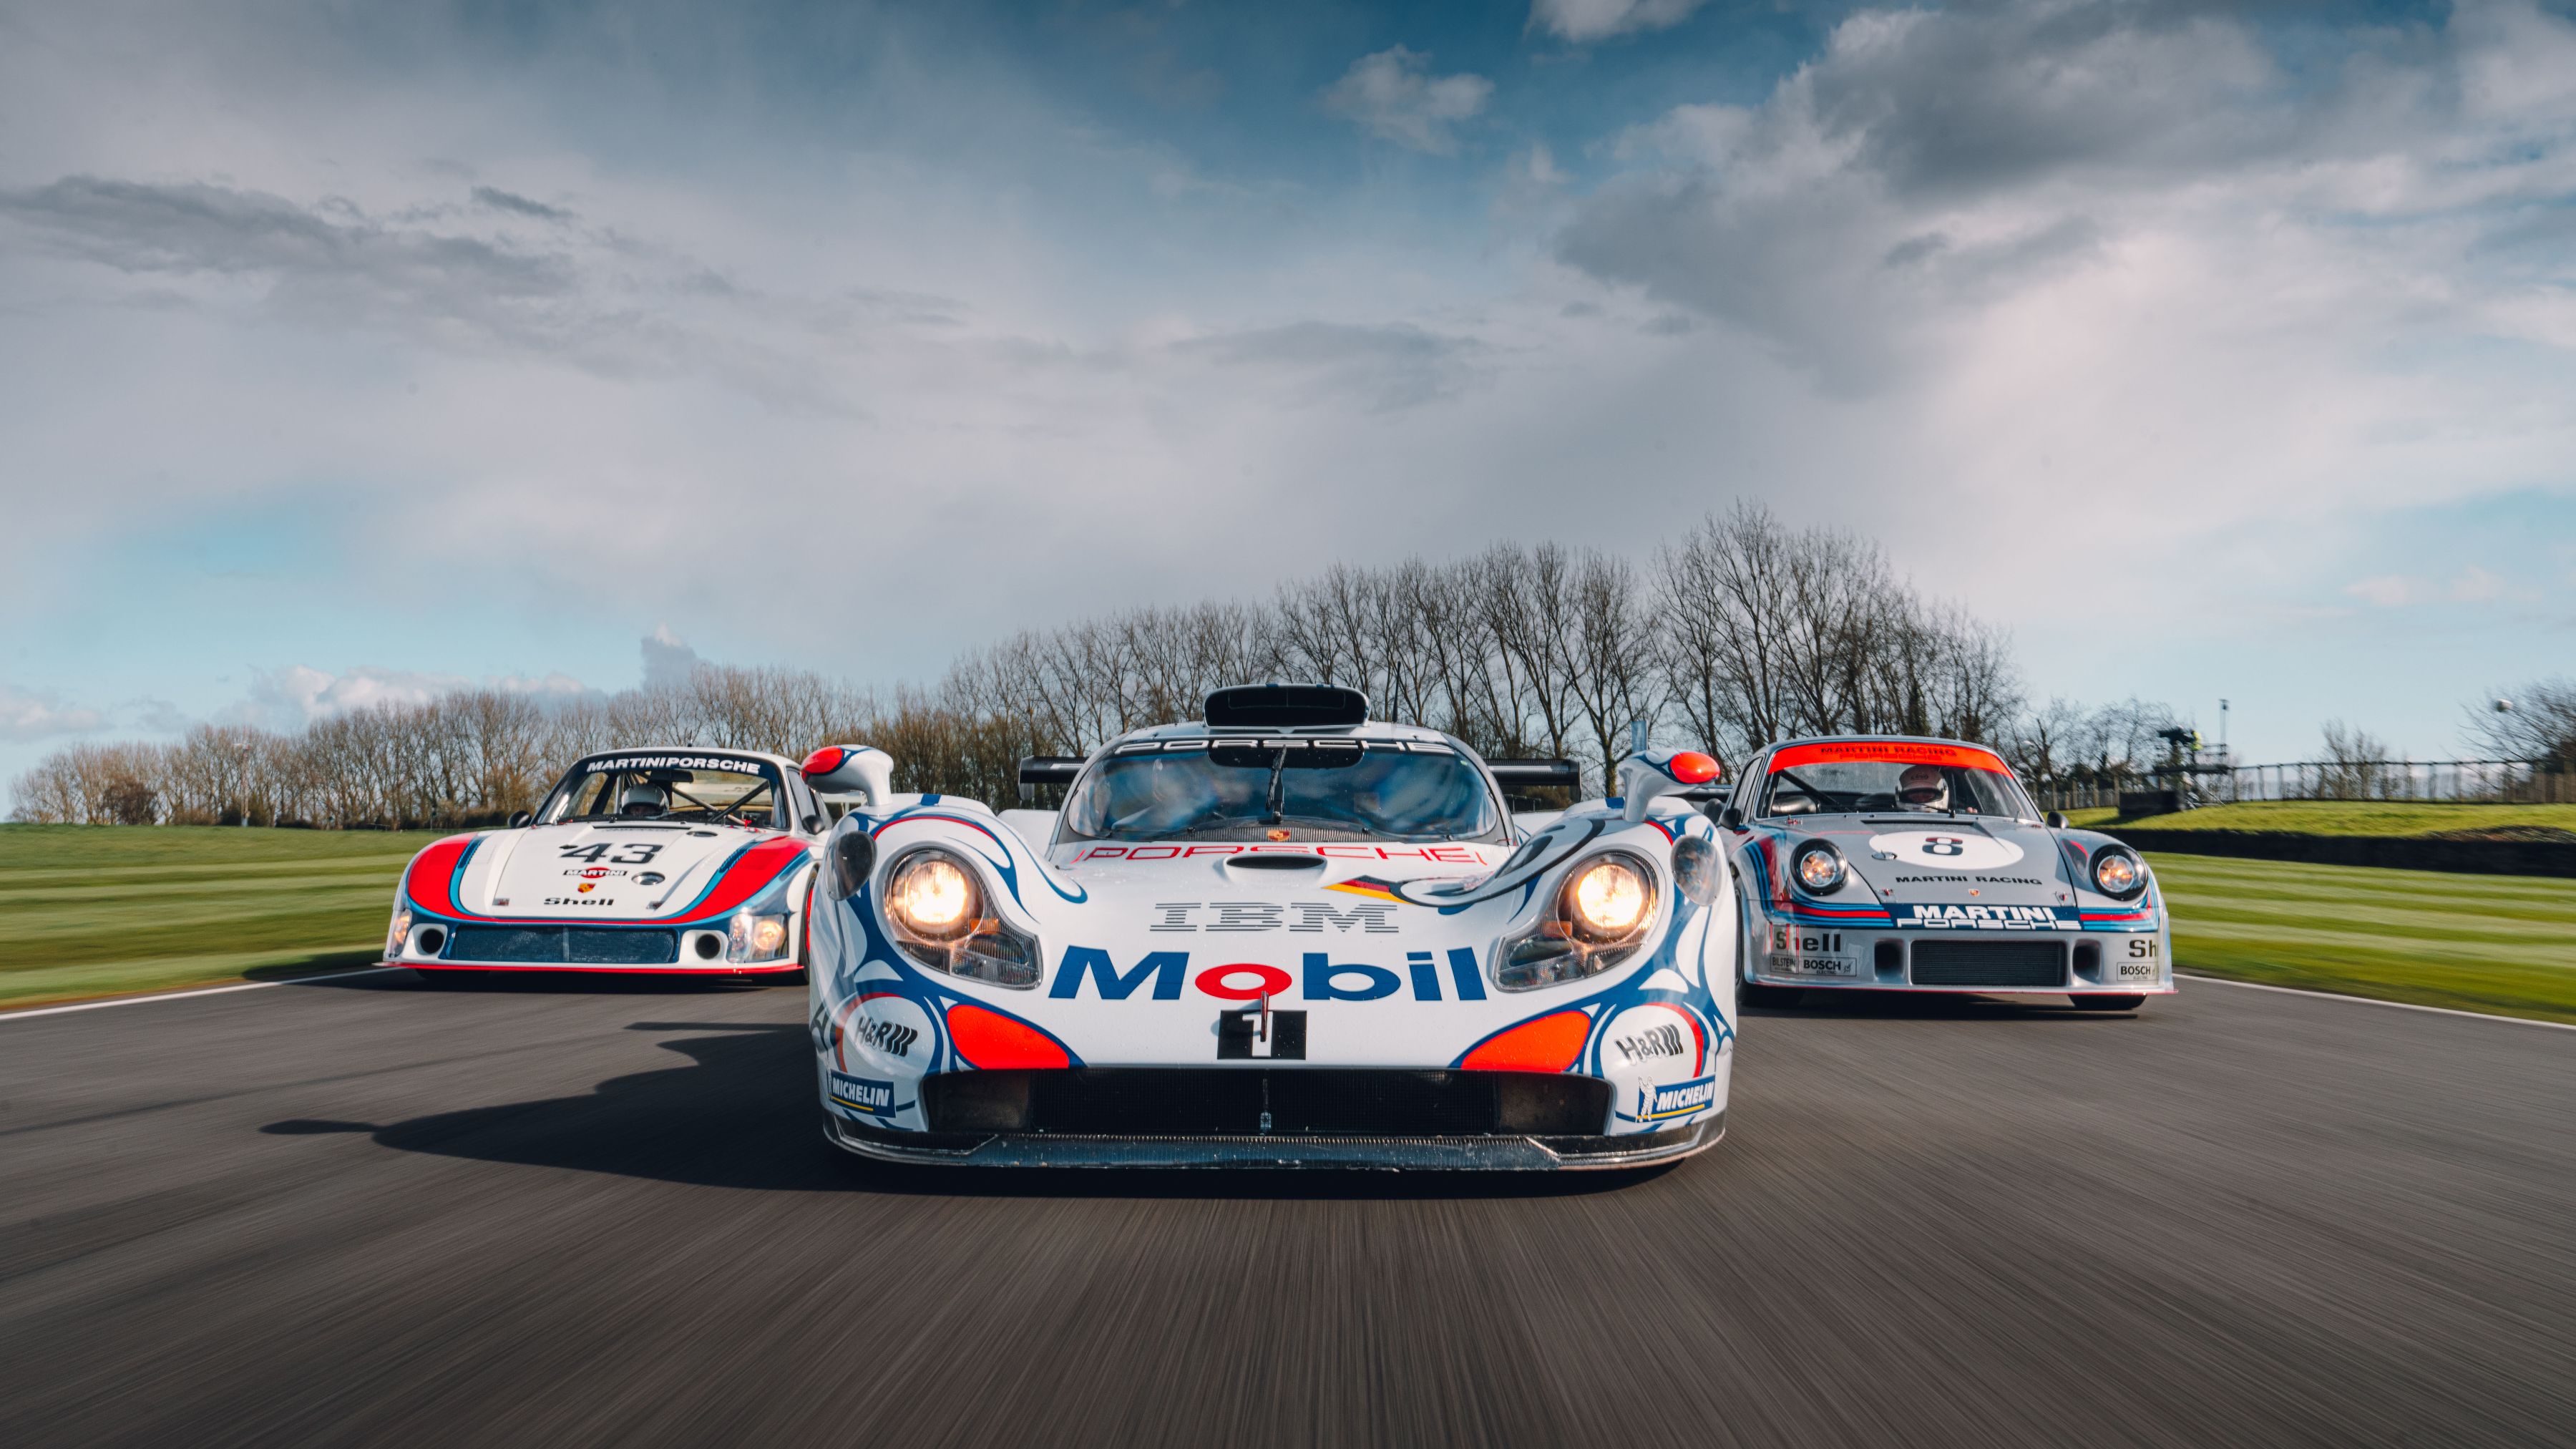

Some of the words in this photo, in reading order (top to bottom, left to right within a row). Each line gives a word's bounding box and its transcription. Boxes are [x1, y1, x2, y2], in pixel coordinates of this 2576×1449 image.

[1116, 739, 1454, 754] PORSCHE
[1820, 744, 1889, 753] MARTINI
[1894, 746, 1958, 757] RACING
[560, 843, 663, 864] 43
[1922, 836, 1963, 856] 8
[1084, 846, 1475, 862] PORSCHE
[1896, 875, 1968, 884] MARTINI
[1975, 876, 2042, 885] RACING
[544, 897, 614, 906] Shell
[1150, 902, 1399, 932] IBM
[1913, 905, 2057, 920] MARTINI
[1897, 918, 2082, 930] PORSCHE
[1048, 945, 1487, 1000] Mobil
[1803, 960, 1841, 970] BOSCH
[2120, 965, 2151, 975] BOSCH
[1242, 1011, 1273, 1057] 1
[832, 1077, 890, 1107] MICHELIN
[1656, 1081, 1714, 1111] MICHELIN
